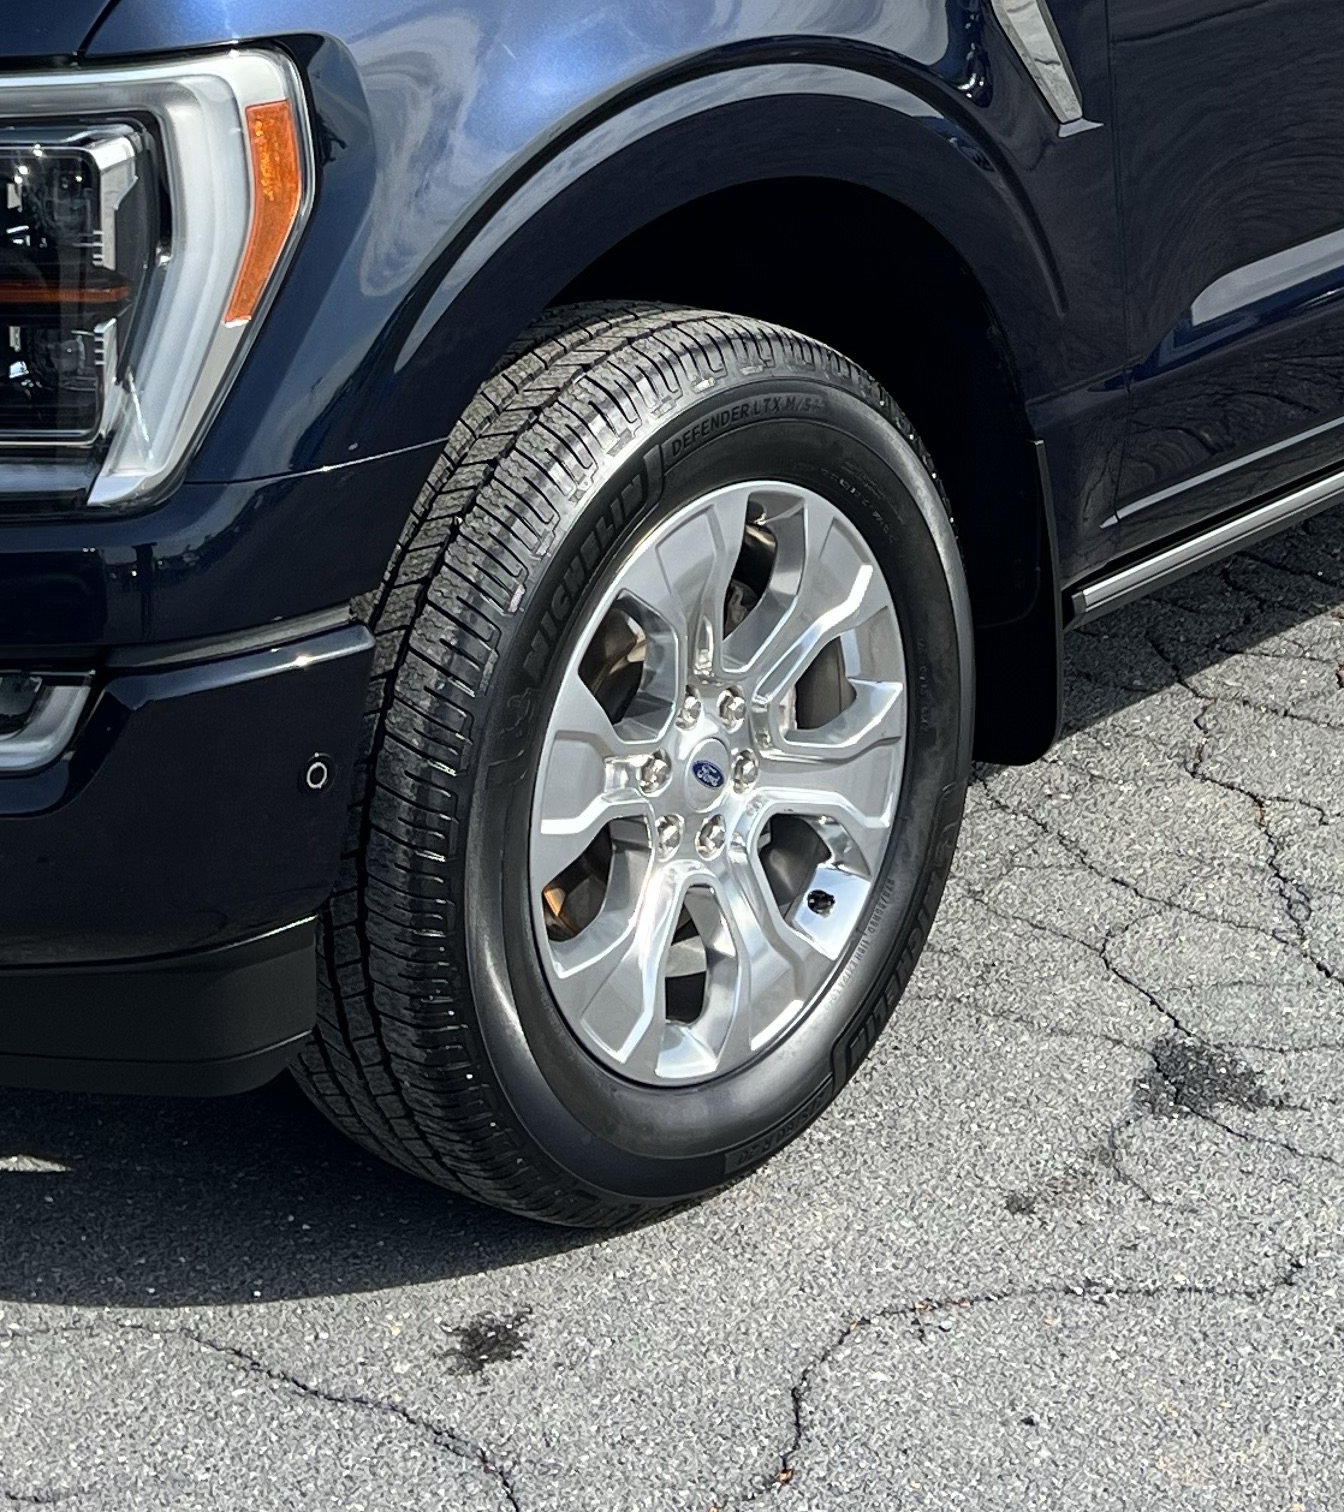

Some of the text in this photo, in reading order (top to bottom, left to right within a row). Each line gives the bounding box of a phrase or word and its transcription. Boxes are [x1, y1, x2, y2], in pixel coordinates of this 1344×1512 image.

[671, 404, 750, 458] DEFENDER
[522, 472, 648, 685] MICHELIN
[696, 764, 722, 787] Ford
